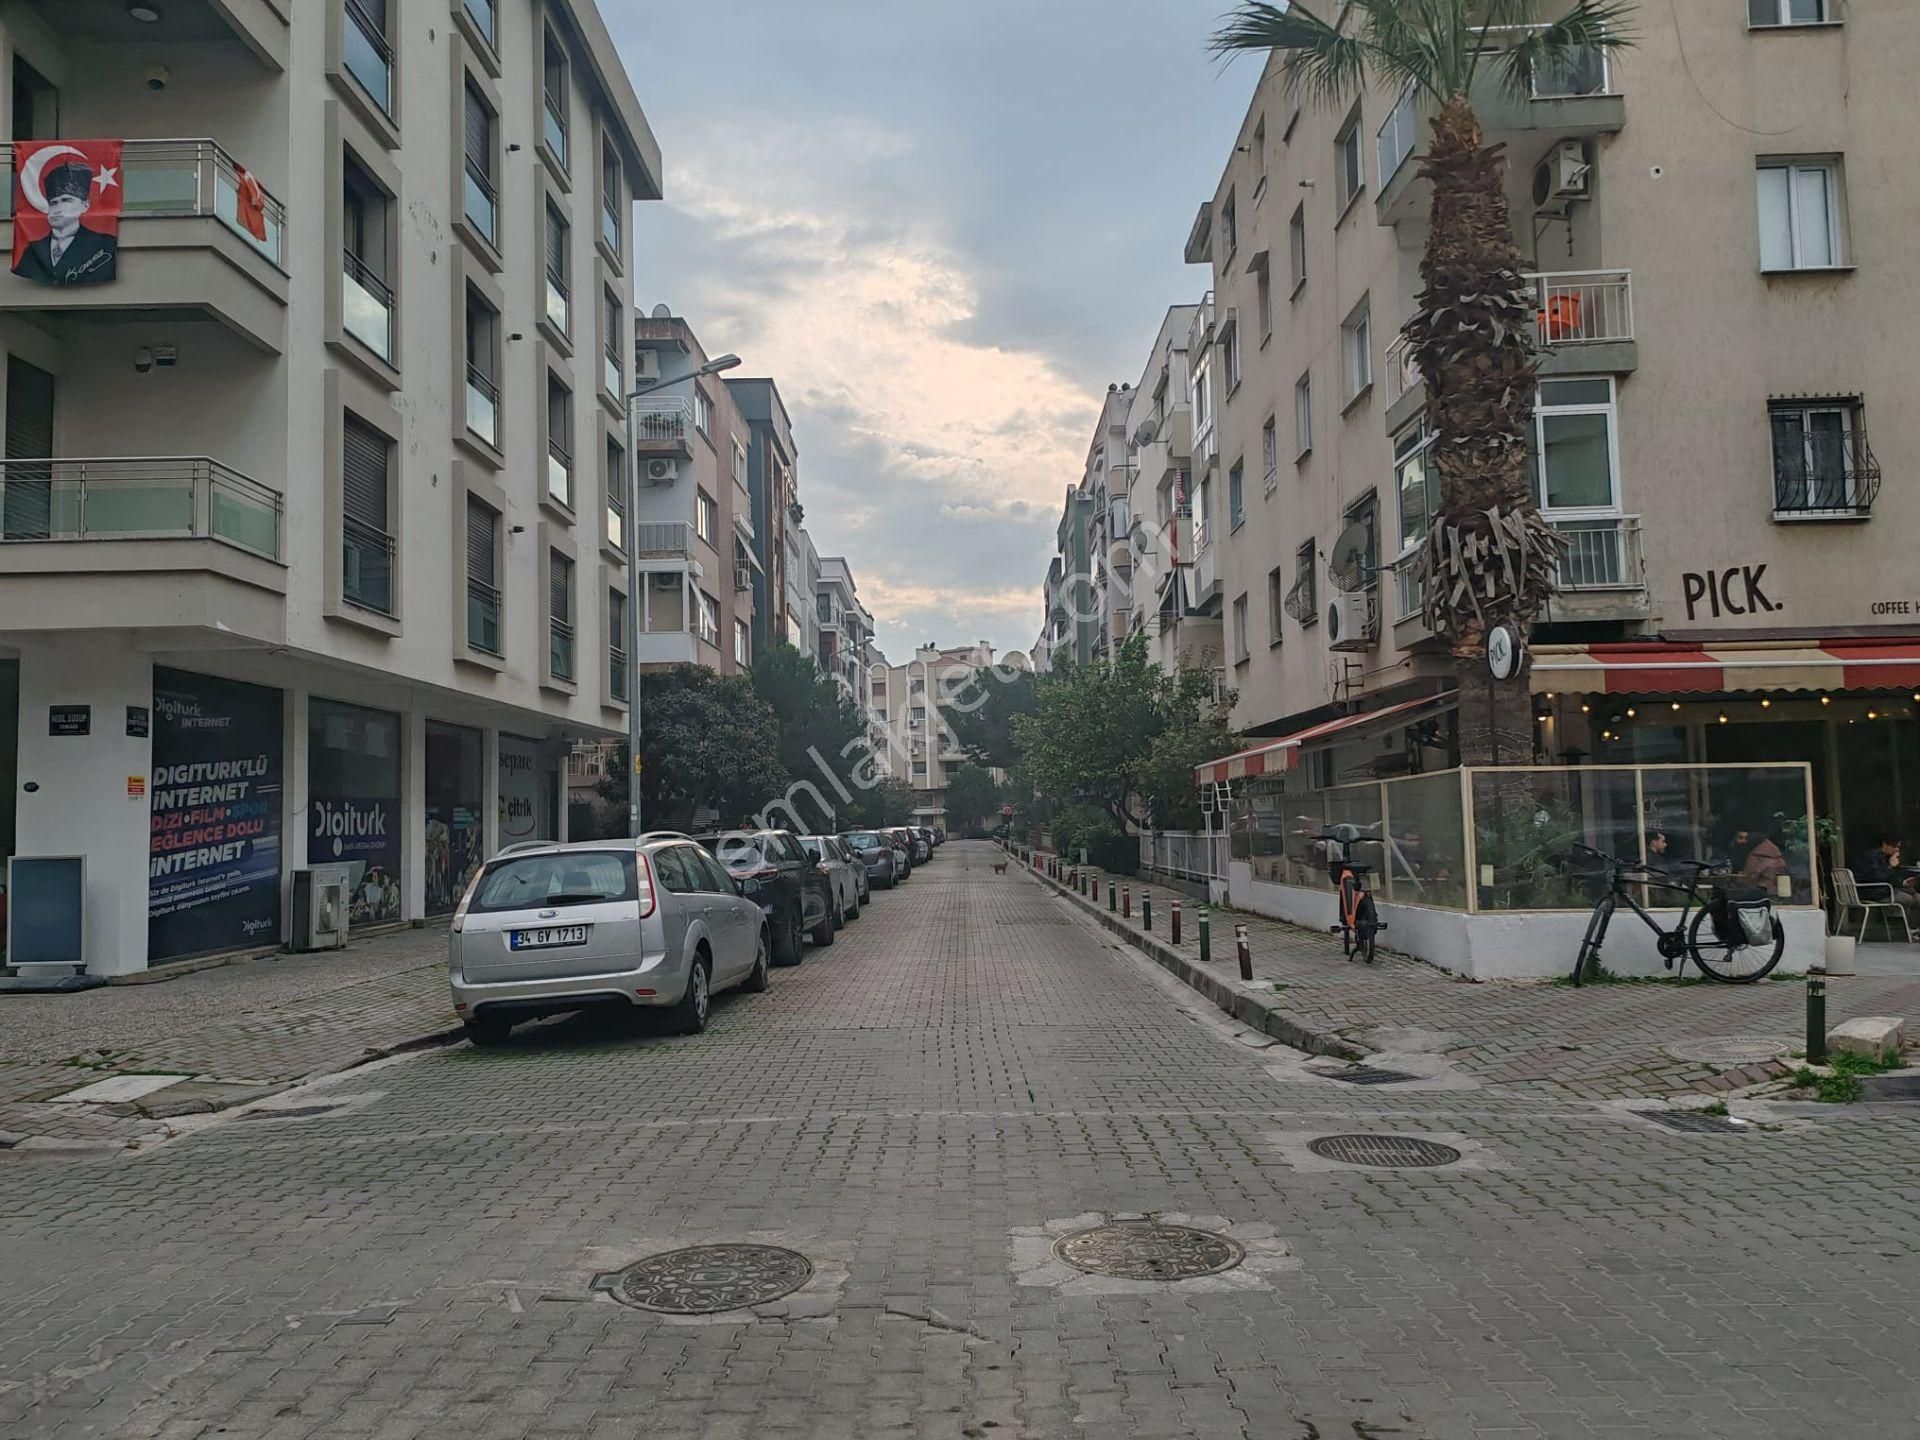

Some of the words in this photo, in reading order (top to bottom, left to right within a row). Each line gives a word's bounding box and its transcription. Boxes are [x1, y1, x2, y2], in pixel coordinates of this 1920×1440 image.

[1683, 564, 1783, 621] PICK.
[1872, 601, 1909, 615] COFFEE
[227, 819, 264, 838] DOLU
[316, 800, 386, 857] Digiturk
[518, 931, 531, 944] 34
[537, 929, 551, 943] GV
[556, 926, 584, 941] 1713
